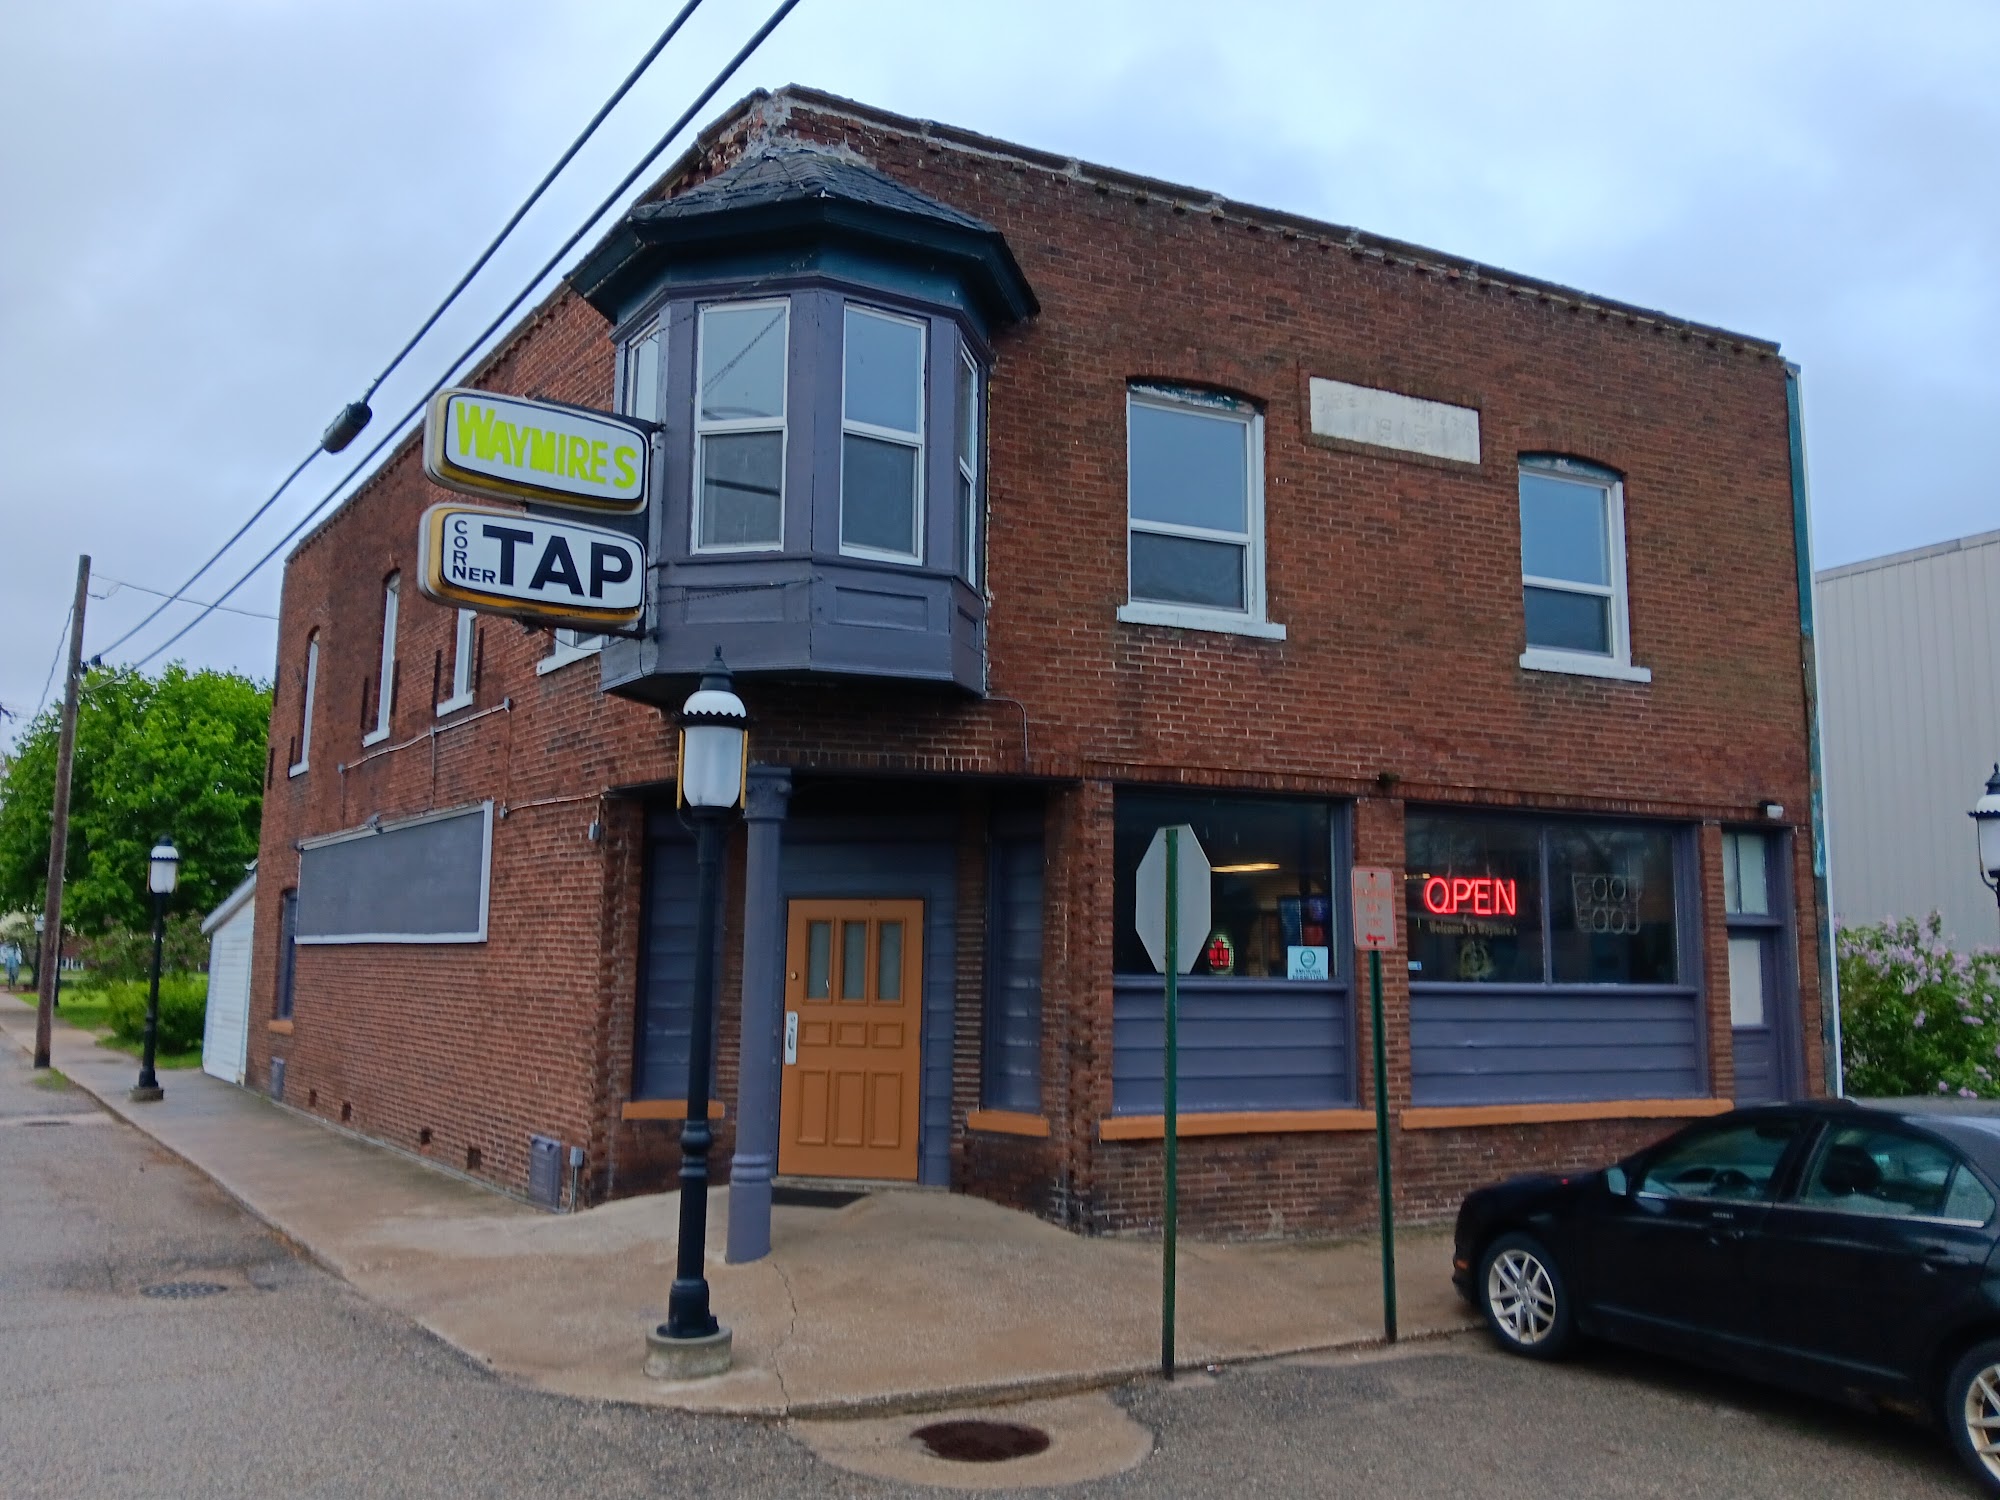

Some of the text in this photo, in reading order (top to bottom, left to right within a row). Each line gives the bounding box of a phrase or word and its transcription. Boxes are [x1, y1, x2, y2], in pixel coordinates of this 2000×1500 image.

[456, 401, 638, 490] WAYMIRES
[452, 520, 633, 599] CORNER TAP
[1423, 876, 1517, 916] OPEN
[1429, 920, 1464, 935] Welcome
